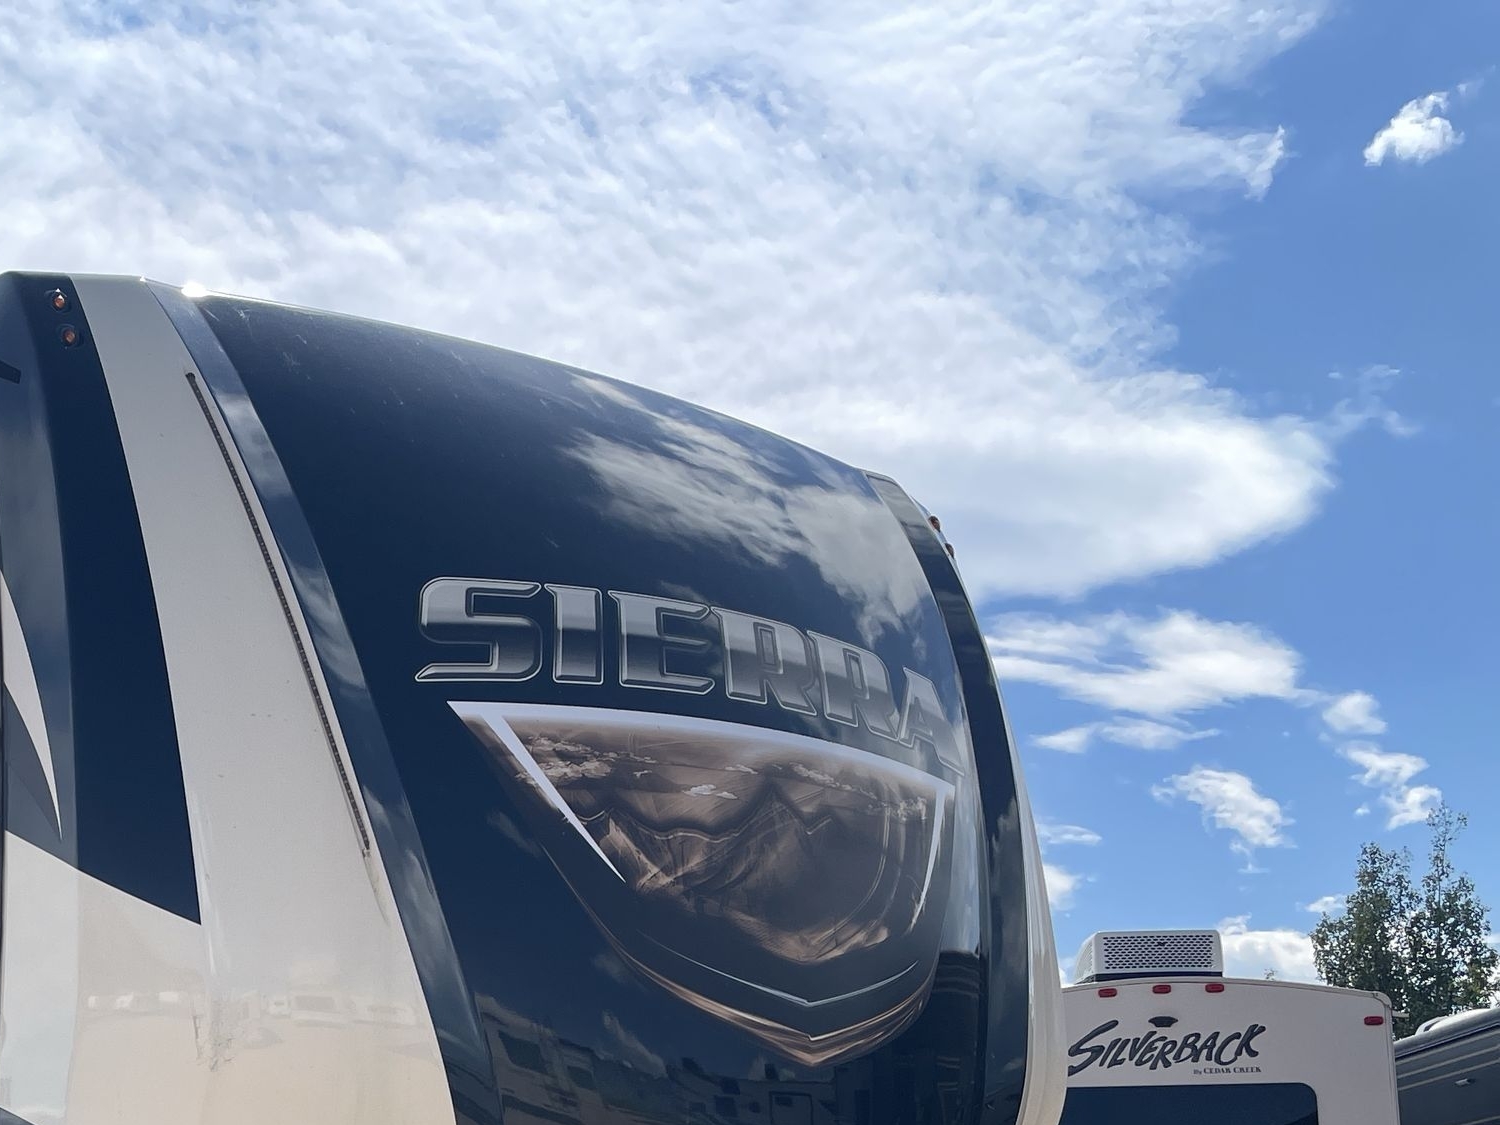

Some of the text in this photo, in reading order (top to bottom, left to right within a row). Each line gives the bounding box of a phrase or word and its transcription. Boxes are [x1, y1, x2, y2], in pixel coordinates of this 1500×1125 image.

[415, 576, 966, 777] SIERRA
[1068, 1019, 1267, 1077] SILVERBACK
[1203, 1066, 1232, 1075] CEDAR
[1233, 1065, 1263, 1074] CREEK
